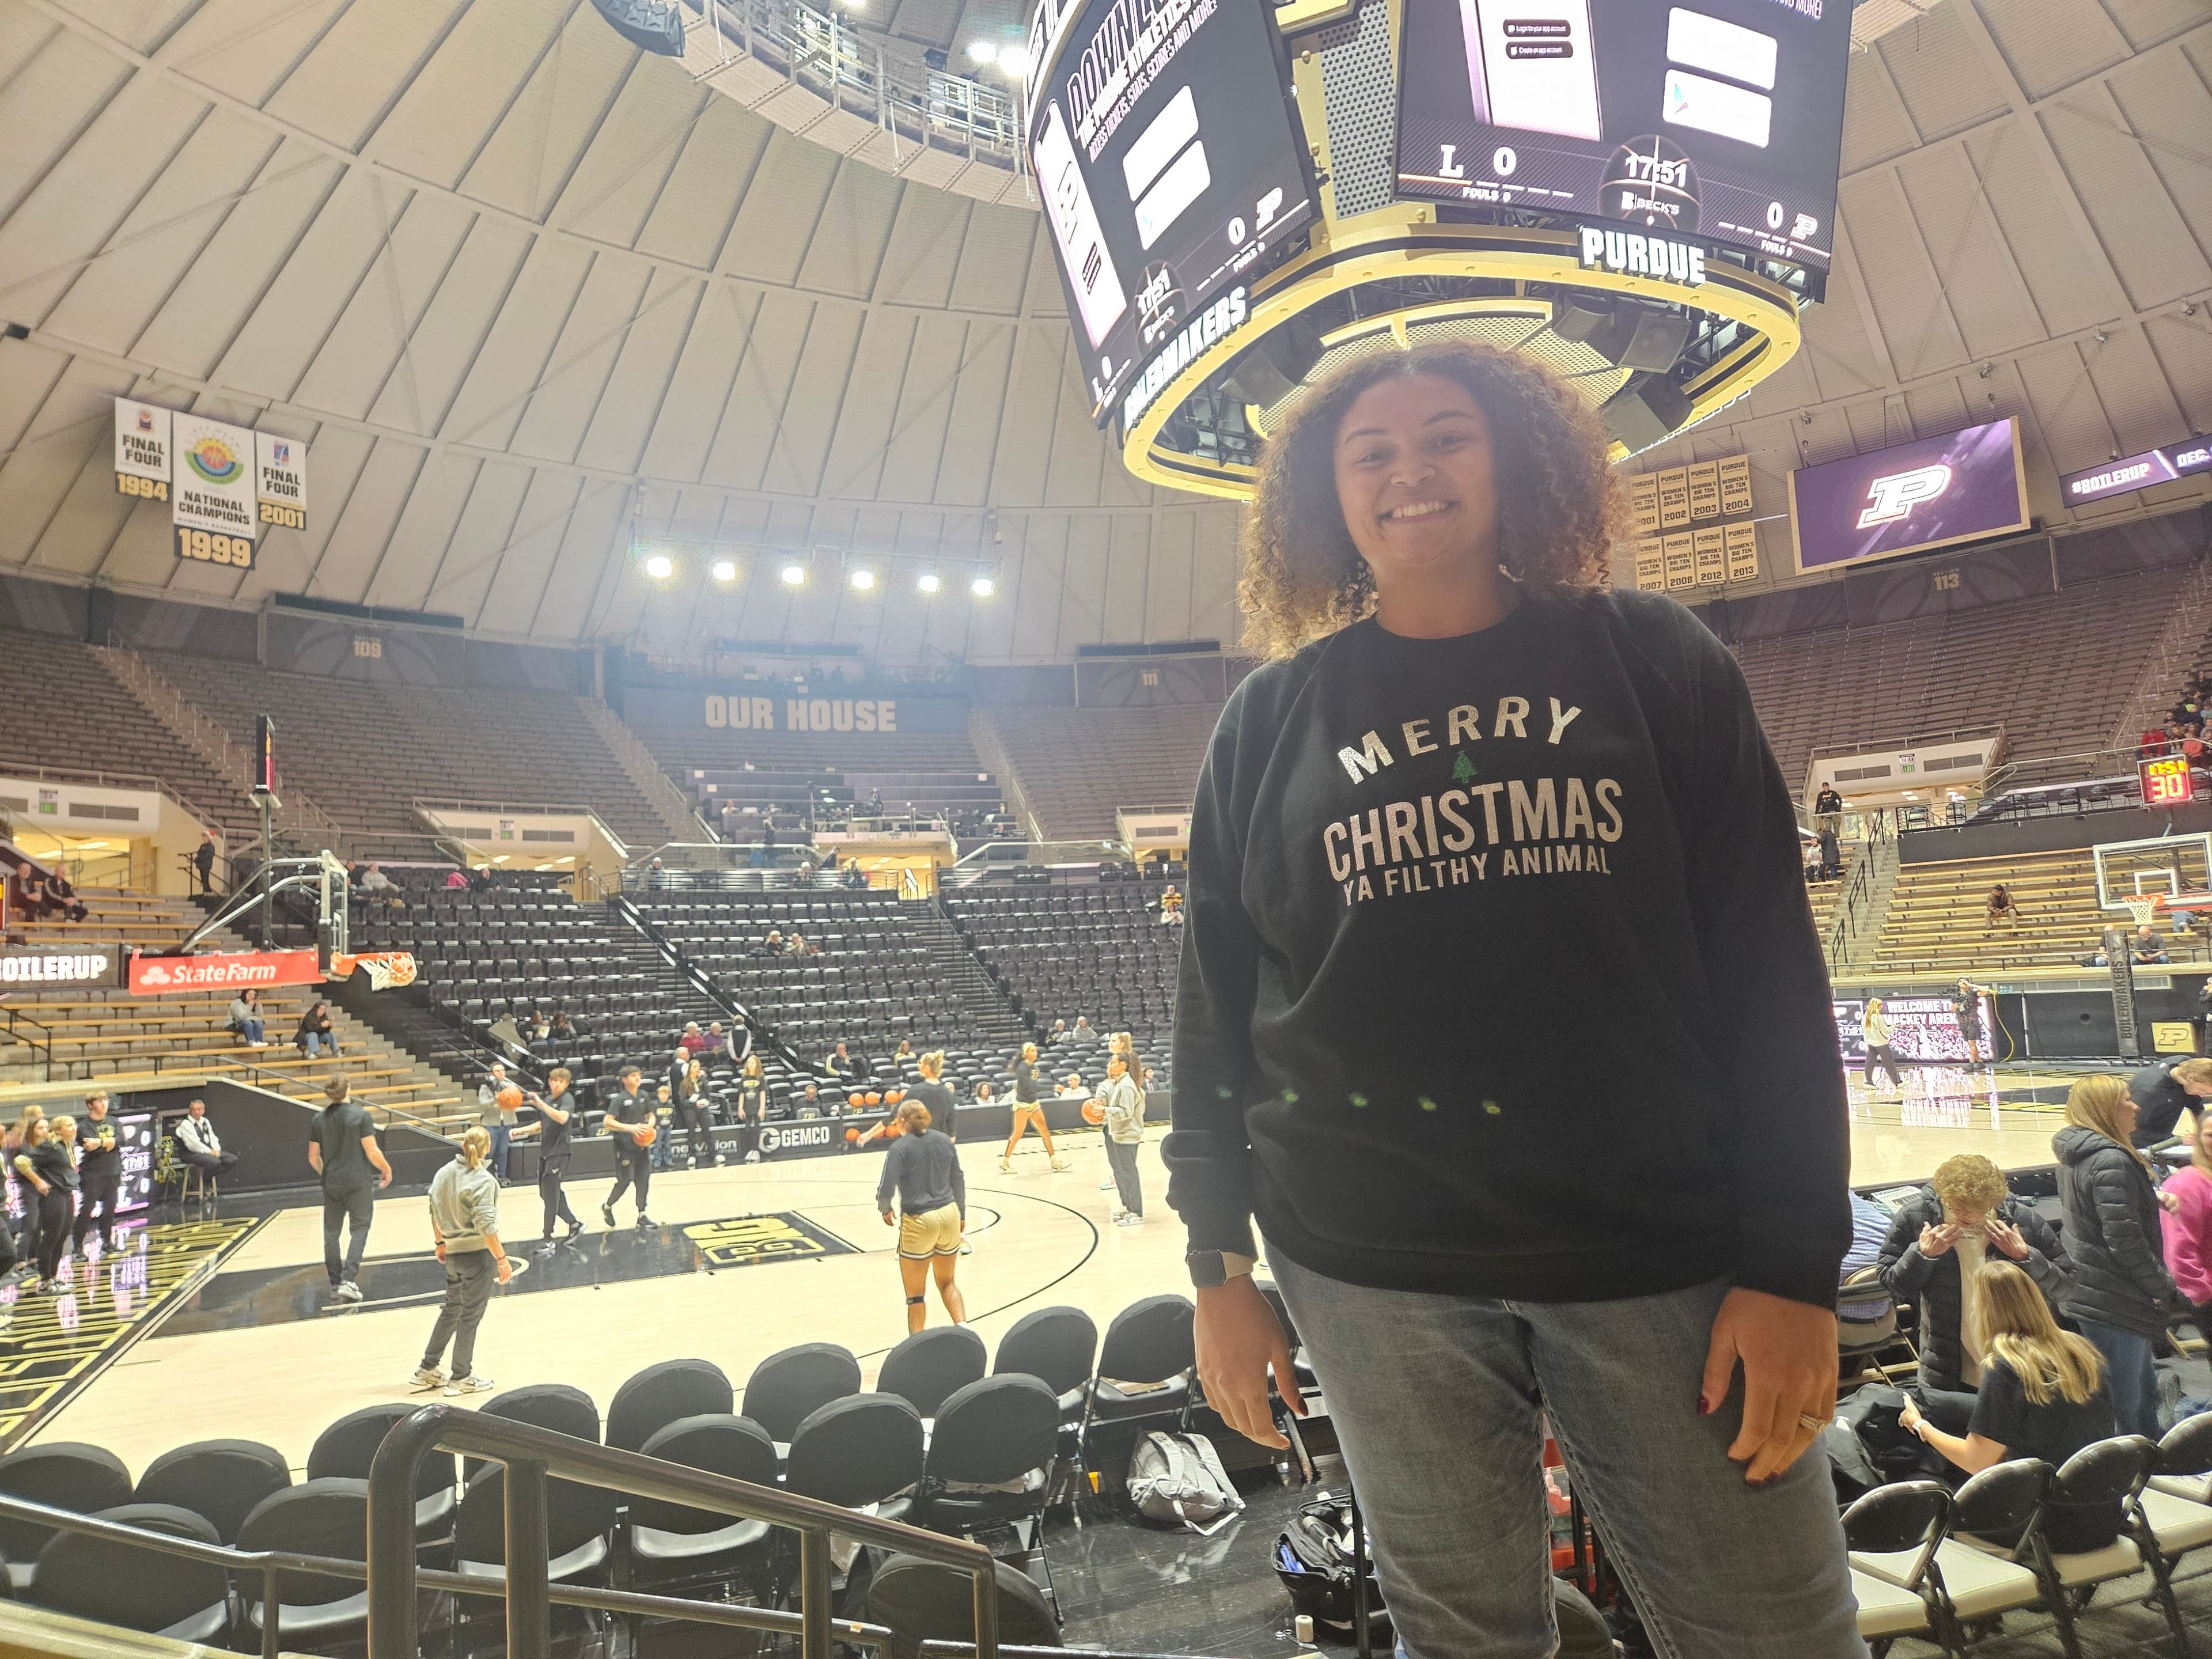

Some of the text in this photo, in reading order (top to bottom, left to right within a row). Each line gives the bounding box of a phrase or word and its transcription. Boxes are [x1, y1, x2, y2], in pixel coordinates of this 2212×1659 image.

[1440, 144, 1517, 179] L 0
[1625, 154, 1687, 188] 17:51
[1463, 186, 1512, 202] FOULS 0
[1637, 198, 1680, 216] BECK'S
[1767, 202, 1783, 229] 0
[1228, 217, 1246, 245] 0
[1581, 227, 1706, 284] PURDUE
[1760, 239, 1785, 255] FOULS
[123, 434, 165, 455] FINAL
[125, 449, 162, 468] FOUR
[1721, 461, 1746, 471] PURDUE
[263, 465, 301, 486] FINAL
[1661, 474, 1684, 482] PURDUE
[1691, 467, 1715, 477] PURDUE
[1722, 475, 1748, 484] WOMEN'S
[2071, 463, 2151, 494] #BOILERUP
[117, 473, 168, 503] 1994
[266, 480, 299, 498] FOUR
[1661, 487, 1686, 495] WOMEN'S
[1691, 481, 1717, 490] WOMEN'S
[1724, 487, 1748, 495] CHAMPS
[184, 490, 245, 513] NATIONAL
[1664, 498, 1685, 507] CHAMPS
[1693, 493, 1715, 501] CHAMPS
[1725, 499, 1749, 510] 2004
[1856, 464, 1952, 529] P
[179, 502, 251, 525] CHAMPIONS
[260, 503, 305, 529] 2001
[1664, 510, 1687, 521] 2002
[1694, 505, 1717, 515] 2003
[1697, 533, 1721, 541] PURDUE
[1728, 528, 1752, 537] PURDUE
[179, 528, 251, 568] 1999
[1666, 539, 1690, 547] PURDUE
[1728, 541, 1755, 550] WOMEN'S
[1637, 558, 1662, 566] WOMEN'S
[1666, 552, 1692, 560] WOMEN'S
[1731, 554, 1754, 562] CHAMPS
[1701, 571, 1722, 581] 2012
[1733, 566, 1753, 577] 2013
[1640, 581, 1661, 590] 2007
[1670, 576, 1692, 586] 2008
[1934, 573, 1960, 590] 113
[353, 640, 381, 658] 109
[705, 695, 897, 732] OUR HOUSE
[1338, 696, 1582, 785] MERRY
[2152, 776, 2183, 800] 30
[1323, 778, 1623, 882] CHRISTMAS
[1343, 844, 1612, 907] YA FILTHY ANIMAL
[0, 955, 108, 982] OILERUP
[1887, 999, 1941, 1013] WELCOME
[2111, 960, 2133, 1040] BOILERMAKERS
[2157, 1028, 2189, 1046] P
[781, 1126, 830, 1148] GEMCO
